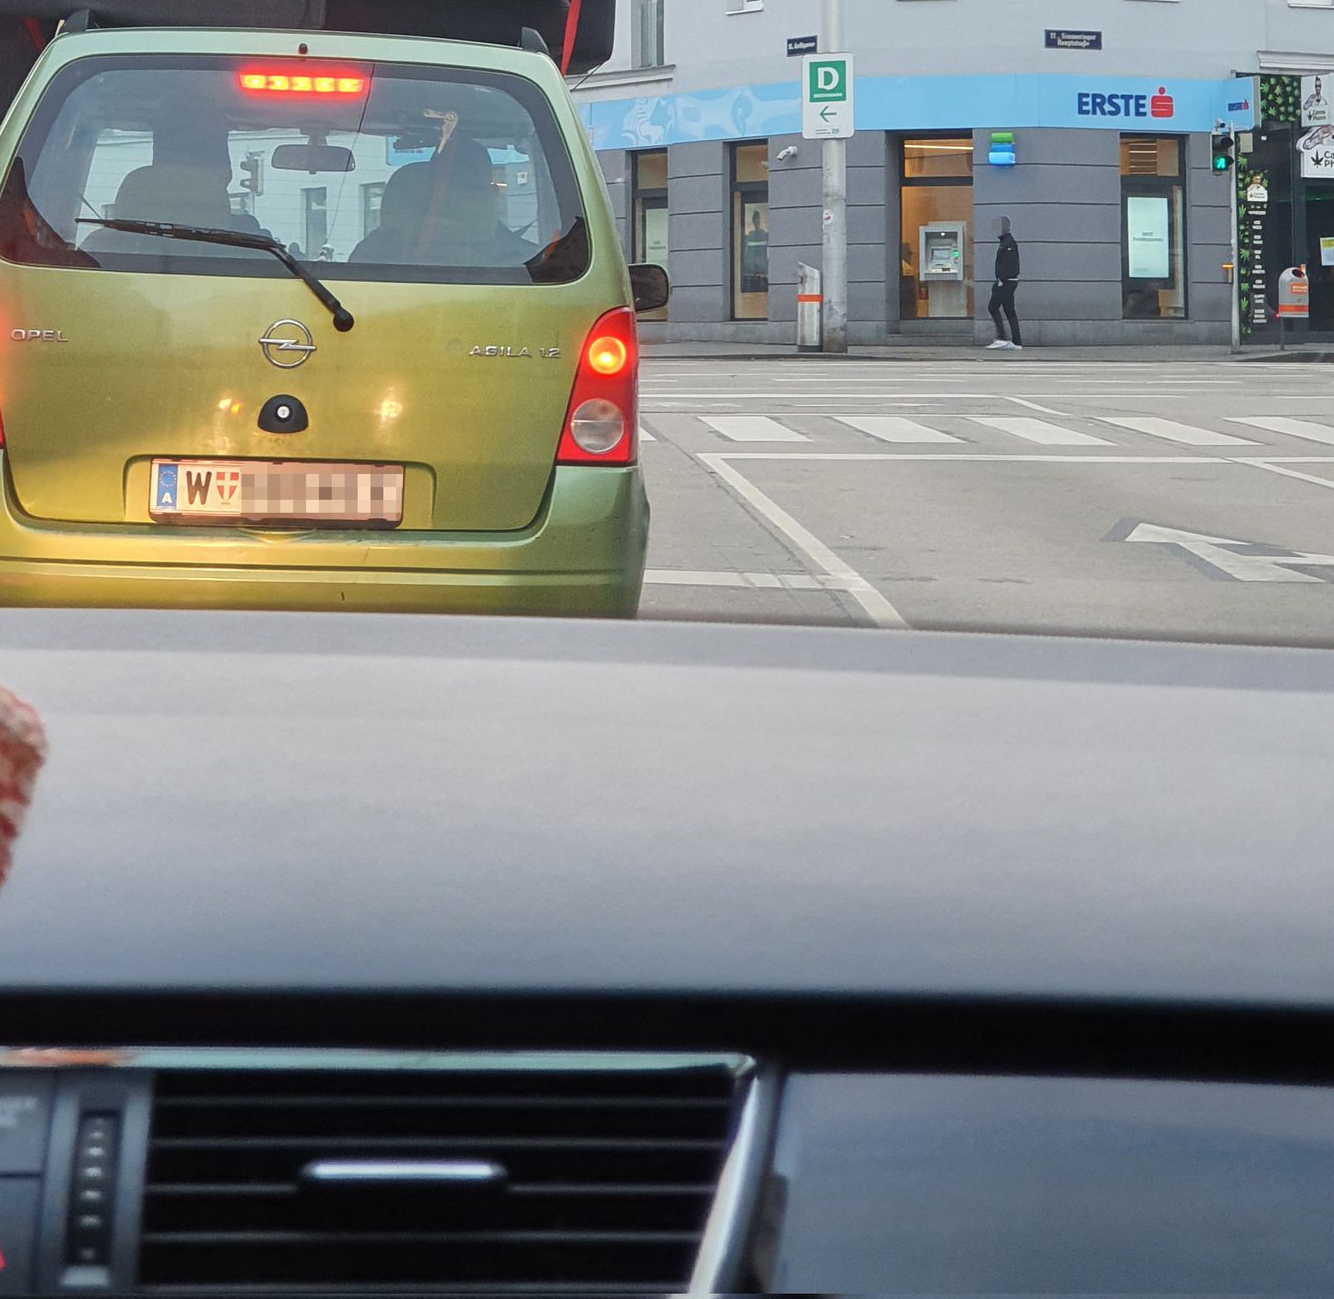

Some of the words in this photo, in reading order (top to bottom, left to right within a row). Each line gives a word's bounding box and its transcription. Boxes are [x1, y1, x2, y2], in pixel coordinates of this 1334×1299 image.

[817, 67, 839, 91] D
[1077, 92, 1147, 117] ERSTE
[11, 328, 69, 342] OPEL
[469, 345, 532, 358] AGILA
[186, 470, 212, 505] W
